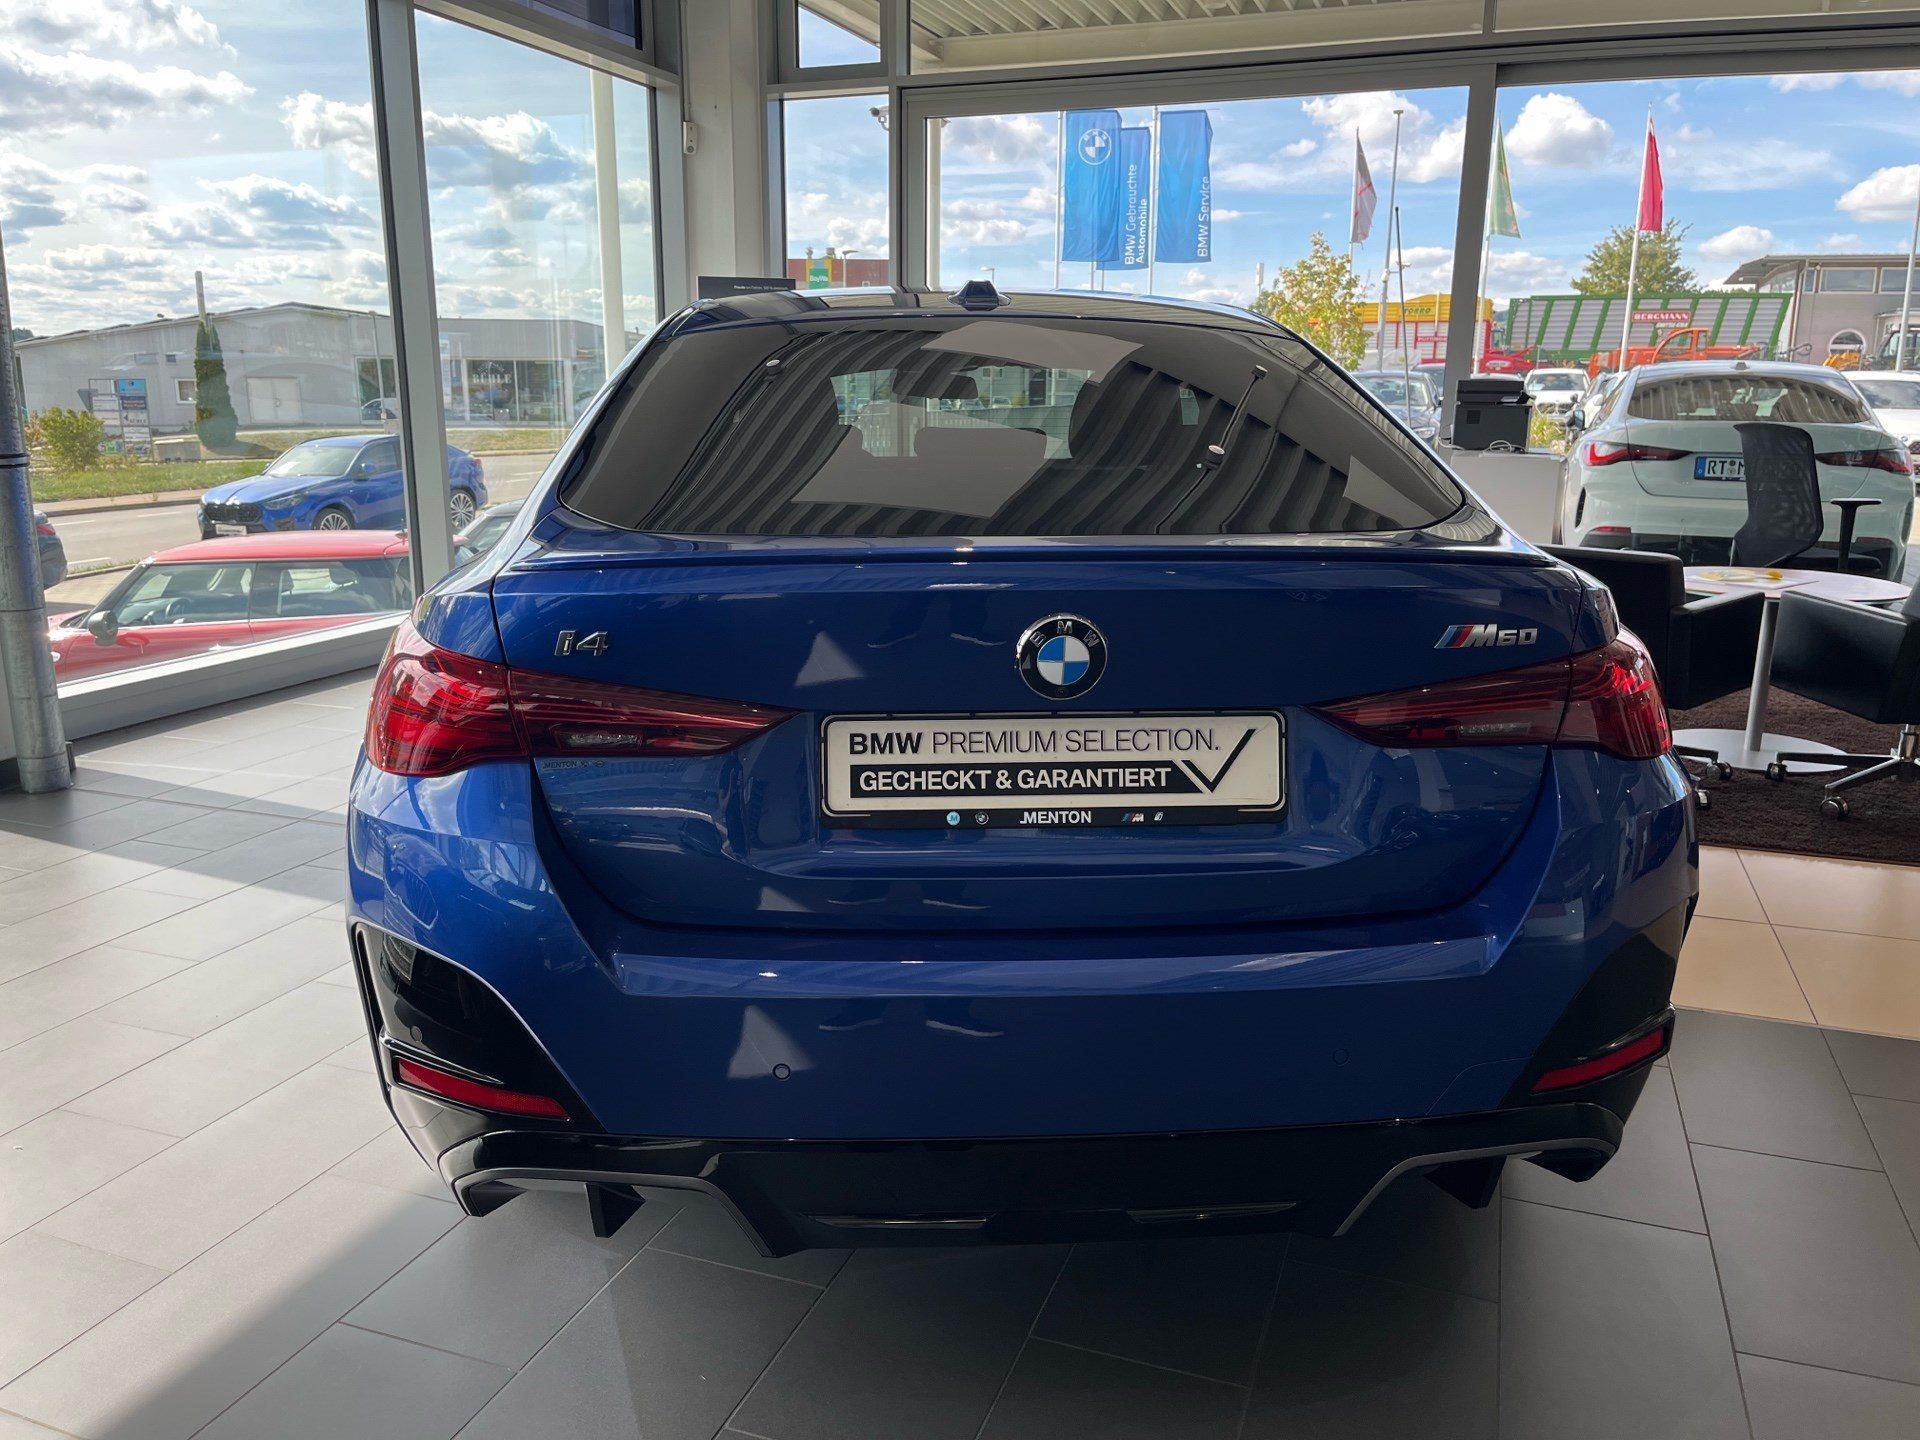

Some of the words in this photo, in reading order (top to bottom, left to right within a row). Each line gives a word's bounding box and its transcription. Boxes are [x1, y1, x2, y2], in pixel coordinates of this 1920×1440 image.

[1126, 164, 1137, 231] Gebrauchte
[1199, 176, 1210, 222] Service
[1135, 198, 1148, 264] Automobile
[1197, 225, 1209, 257] BMW
[1125, 235, 1135, 265] BMW
[1707, 460, 1727, 475] RT
[554, 630, 608, 656] i4
[848, 732, 922, 755] BMW
[932, 730, 1056, 754] PREMIUM
[1065, 728, 1220, 752] SELECTION.
[859, 769, 991, 792] GECHECKT
[996, 769, 1013, 789] &
[1020, 767, 1172, 789] GARANTIERT
[1020, 811, 1092, 824] MENTON
